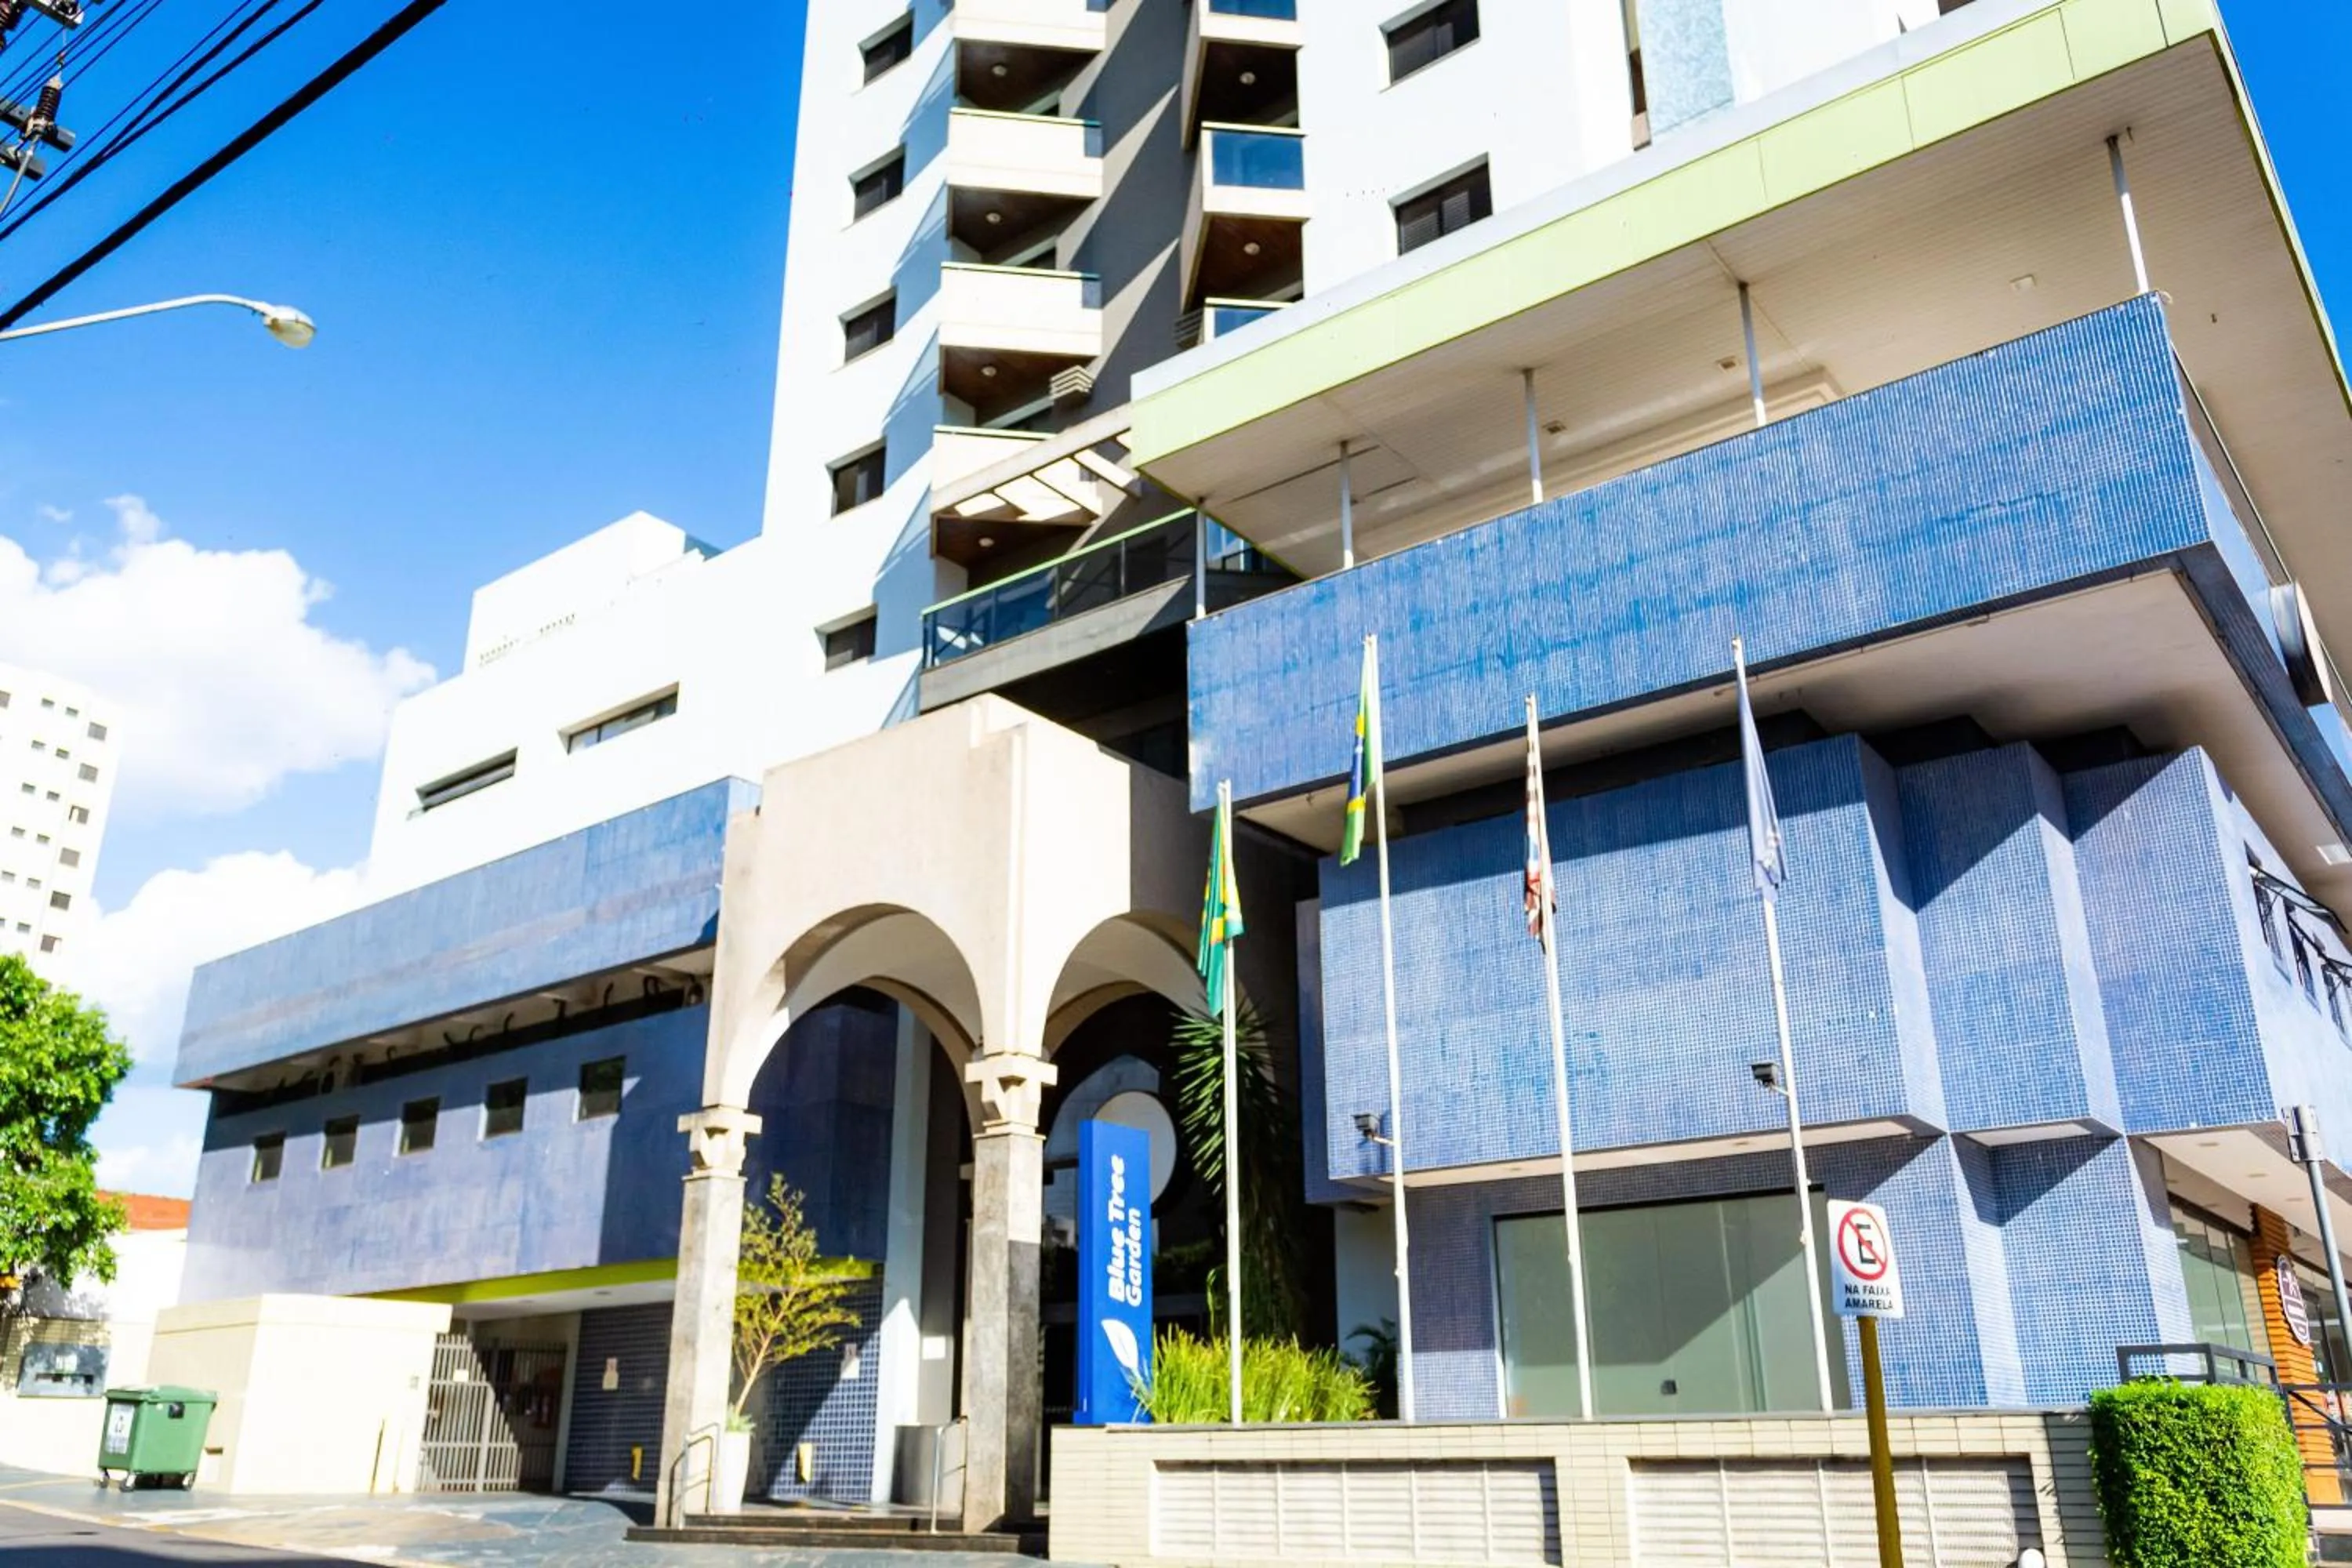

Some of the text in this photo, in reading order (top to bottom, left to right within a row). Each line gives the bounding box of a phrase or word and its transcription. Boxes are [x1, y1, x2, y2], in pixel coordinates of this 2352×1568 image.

[1107, 1154, 1125, 1302] Blue Tree
[1126, 1207, 1142, 1307] Garden
[1845, 1283, 1859, 1294] NA
[1845, 1298, 1893, 1310] AMARELA
